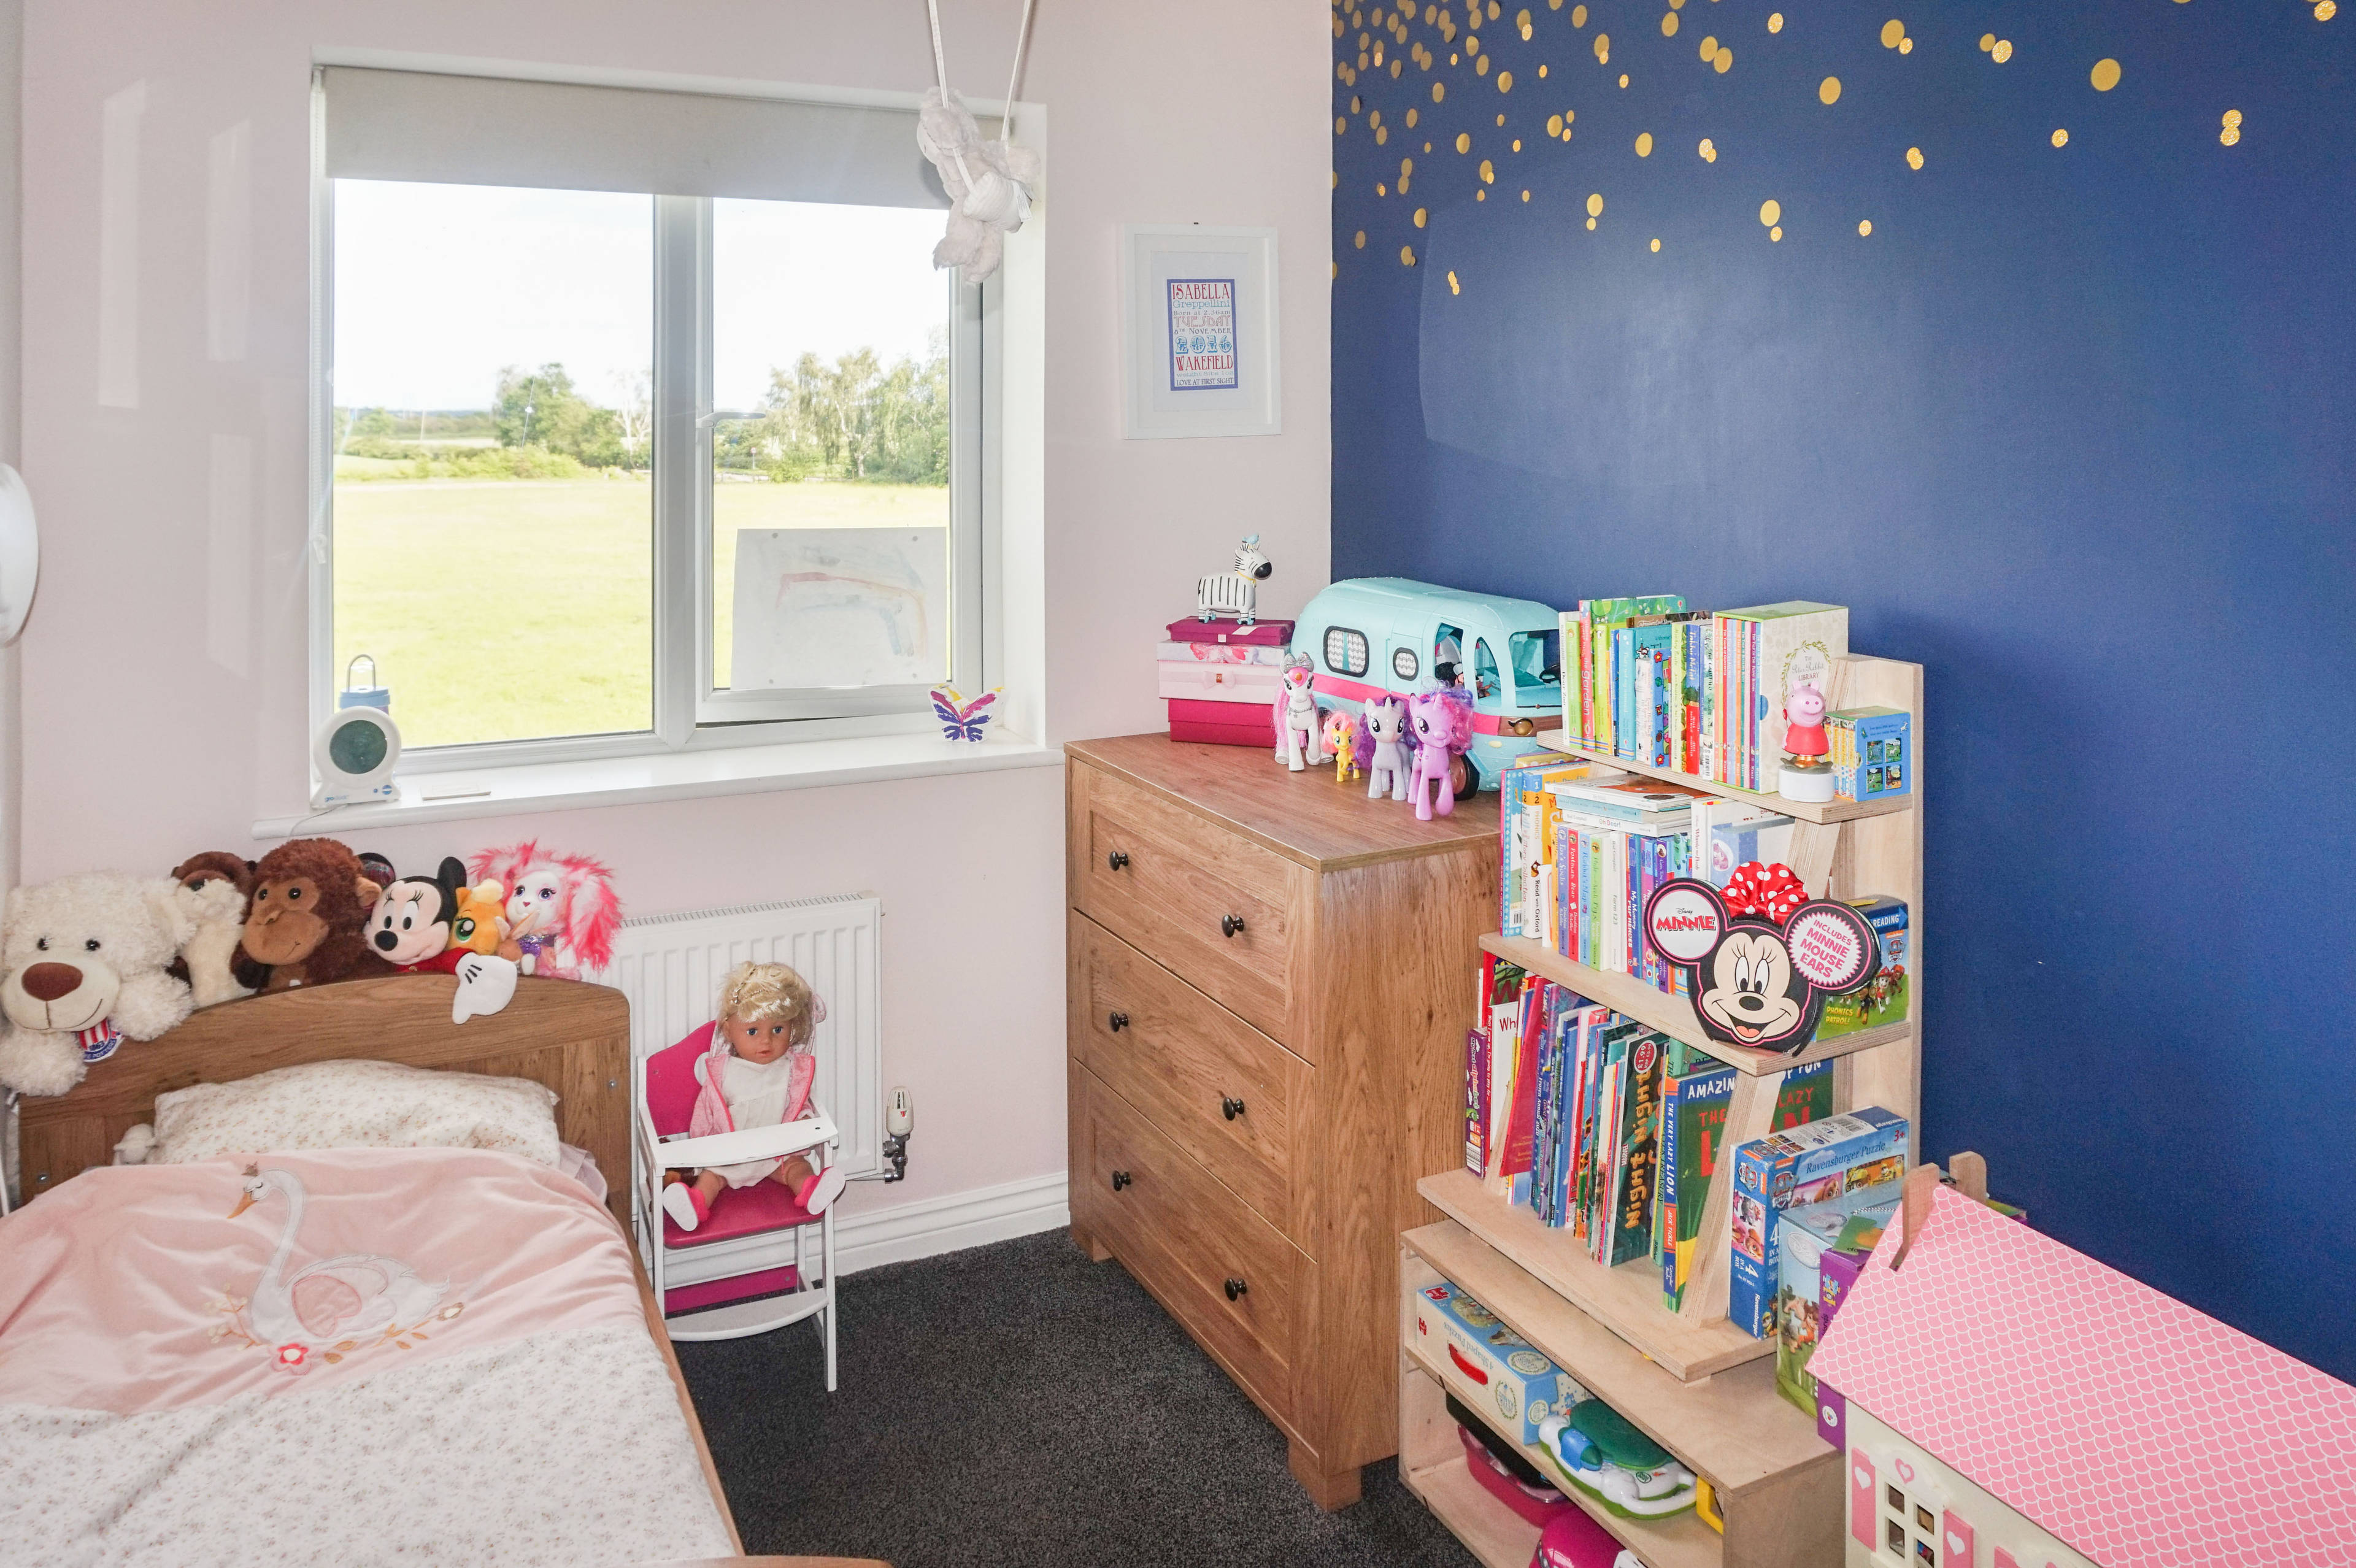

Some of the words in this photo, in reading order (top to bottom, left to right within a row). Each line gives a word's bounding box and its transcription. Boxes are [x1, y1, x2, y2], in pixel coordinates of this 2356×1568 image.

[1172, 284, 1230, 299] ISABELLA
[1173, 315, 1231, 328] TUESDAY
[1175, 335, 1232, 354] 2016
[1176, 355, 1233, 371] WAKEFIELD
[1798, 672, 1819, 681] LIBRARY
[1581, 671, 1592, 715] garden
[1534, 779, 1539, 790] 1
[1630, 890, 1637, 901] My
[1656, 915, 1716, 931] MINNIE
[1873, 915, 1900, 928] READING
[1813, 919, 1852, 946] INCLUDES
[1806, 928, 1850, 958] MINNIE
[1800, 938, 1845, 970] MOUSE
[1800, 953, 1833, 978] EARS
[1827, 1006, 1853, 1017] PHONICS
[1638, 1045, 1646, 1069] £1.99
[1688, 1077, 1735, 1099] AMAZIN
[1699, 1109, 1727, 1128] THE
[1894, 1129, 1905, 1142] 3+
[1806, 1150, 1860, 1174] Ravensburger
[1861, 1141, 1886, 1157] Puzzle
[1770, 1223, 1779, 1246] 4
[1746, 1264, 1759, 1278] 4
[1752, 1293, 1761, 1337] Ravensburger
[1444, 1321, 1466, 1346] Puzzles
[1466, 1341, 1489, 1367] Shaped
